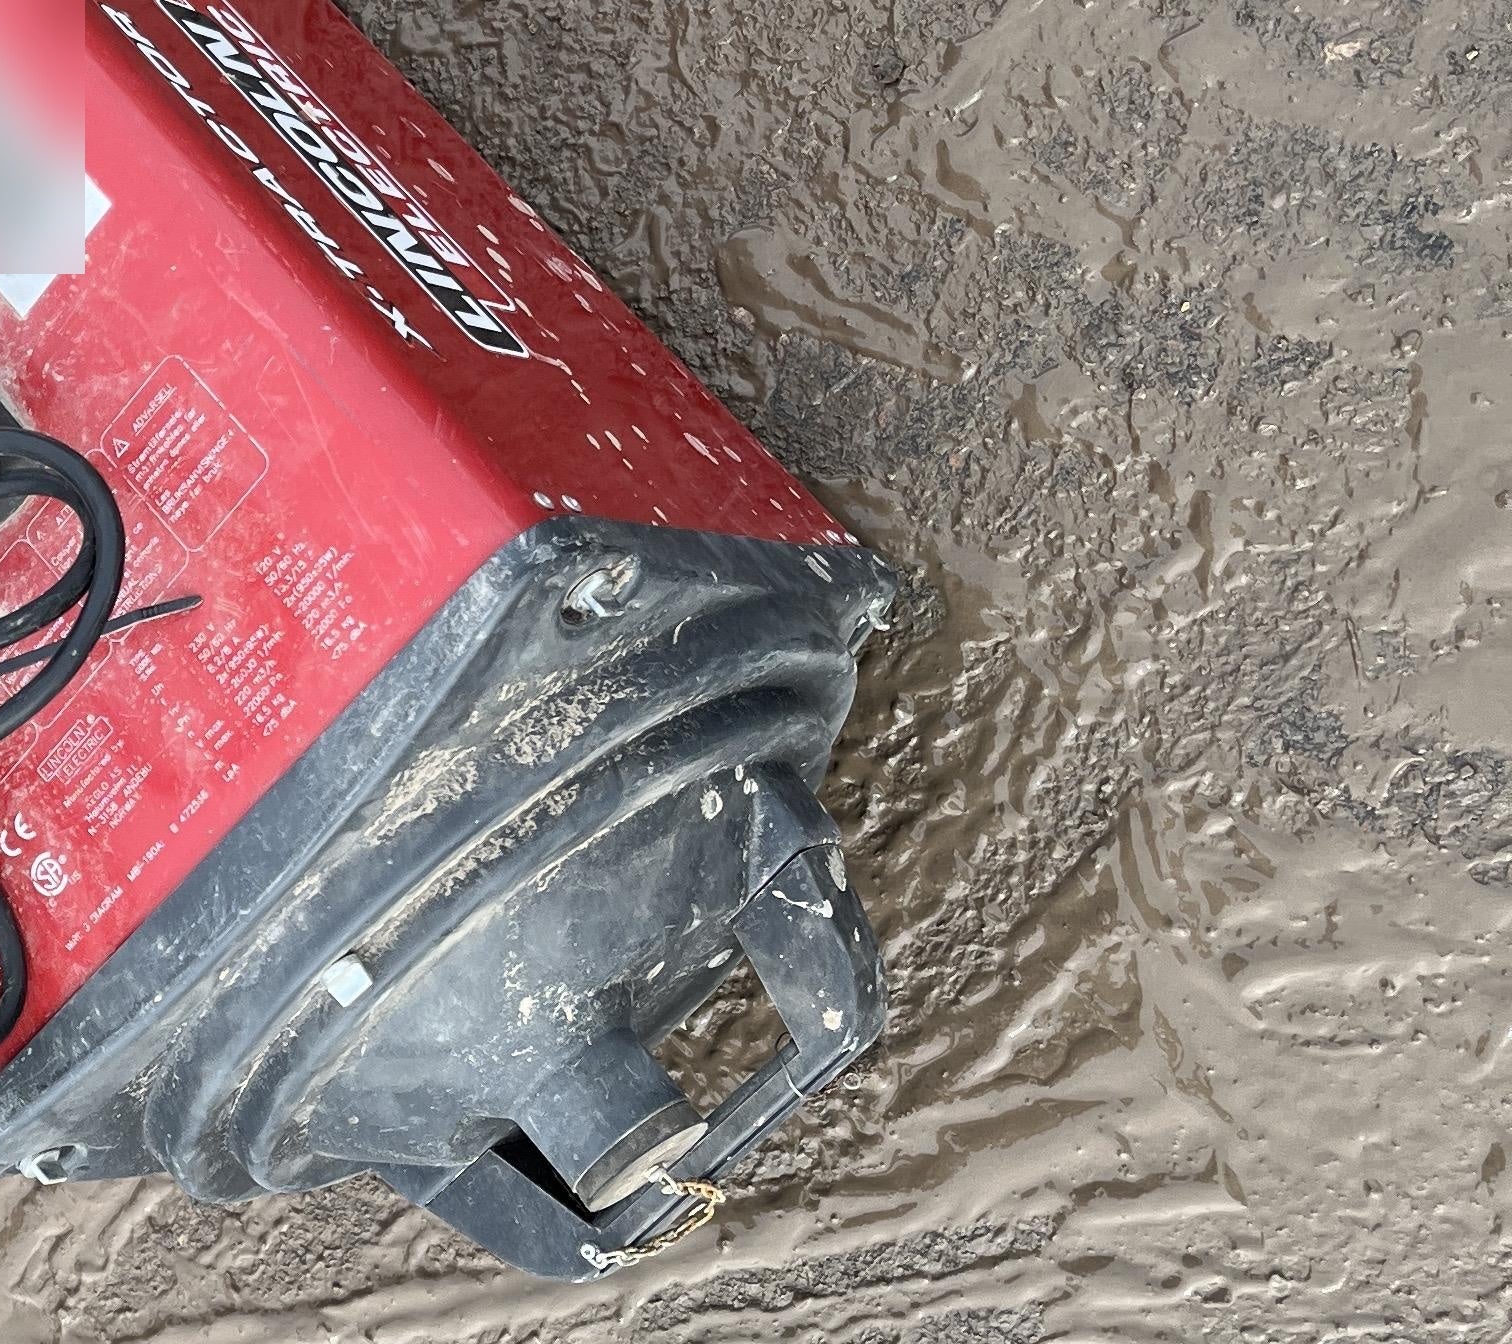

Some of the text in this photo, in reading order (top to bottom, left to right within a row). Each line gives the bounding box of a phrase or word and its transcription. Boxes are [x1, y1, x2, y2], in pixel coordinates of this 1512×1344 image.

[203, 4, 473, 268] ELECTRIC
[179, 21, 504, 329] LINCOLN
[255, 555, 273, 575] 120
[41, 724, 86, 775] LINCOLN
[62, 729, 103, 776] ELECTRIC
[0, 809, 37, 857] CE
